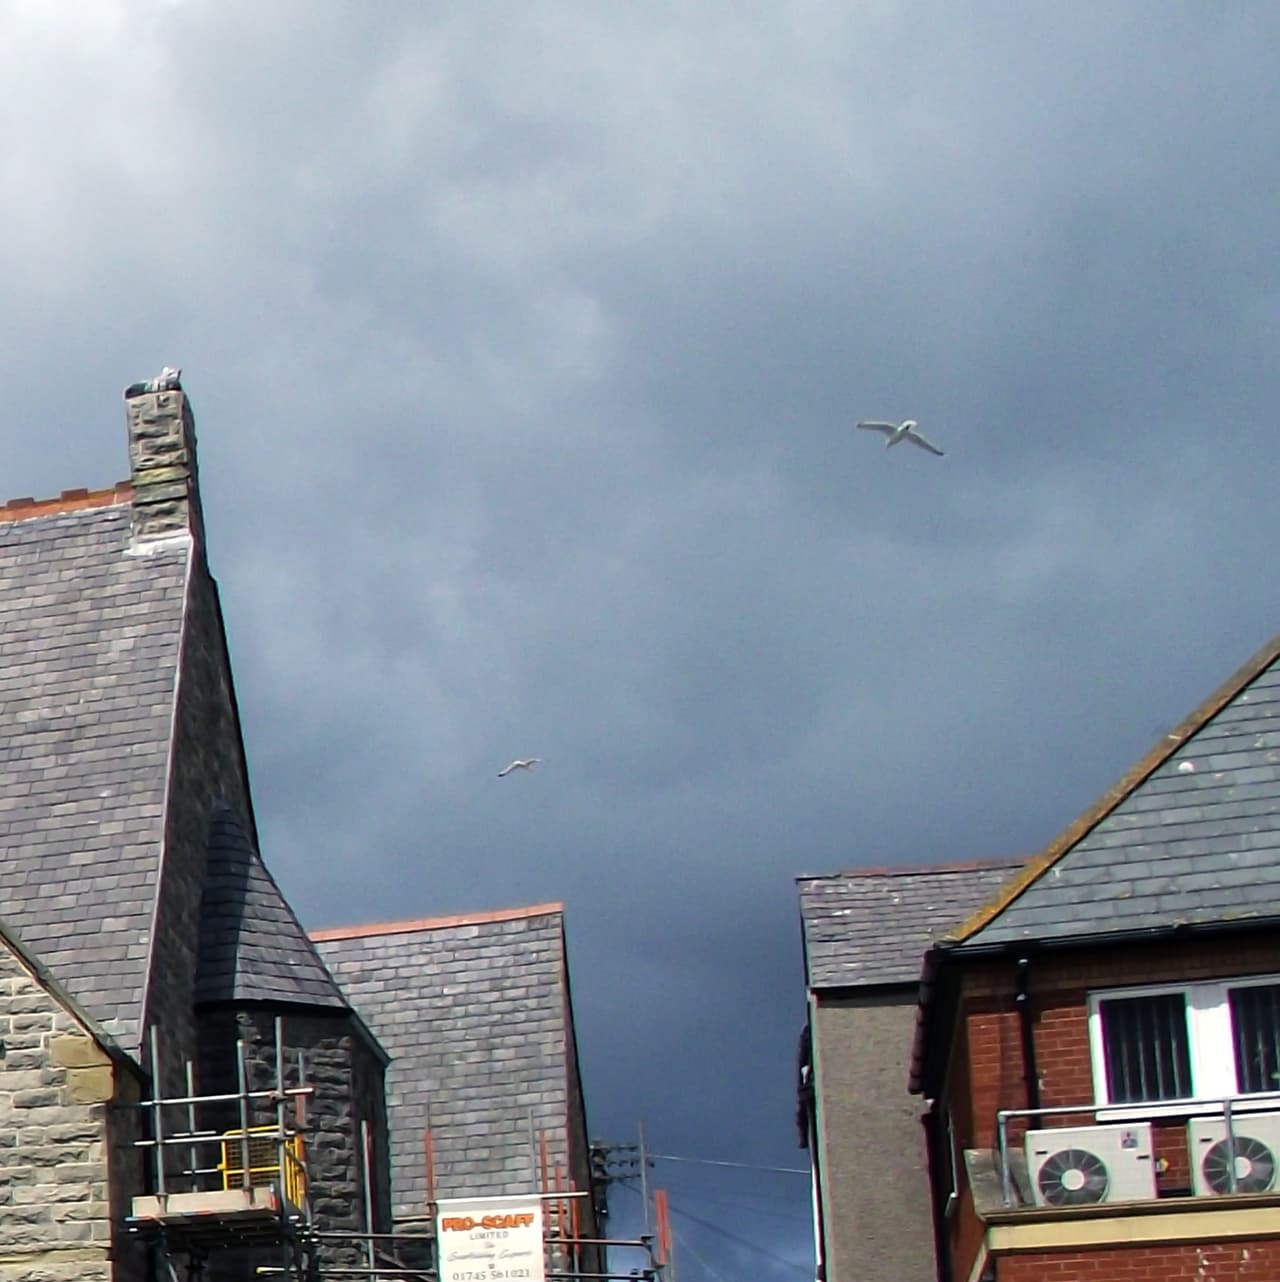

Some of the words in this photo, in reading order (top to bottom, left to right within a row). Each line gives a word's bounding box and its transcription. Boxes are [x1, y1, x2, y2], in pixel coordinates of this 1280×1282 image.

[442, 1213, 535, 1232] PRO-SCAFF
[470, 1231, 509, 1240] LIMITED
[452, 1271, 486, 1280] 01745
